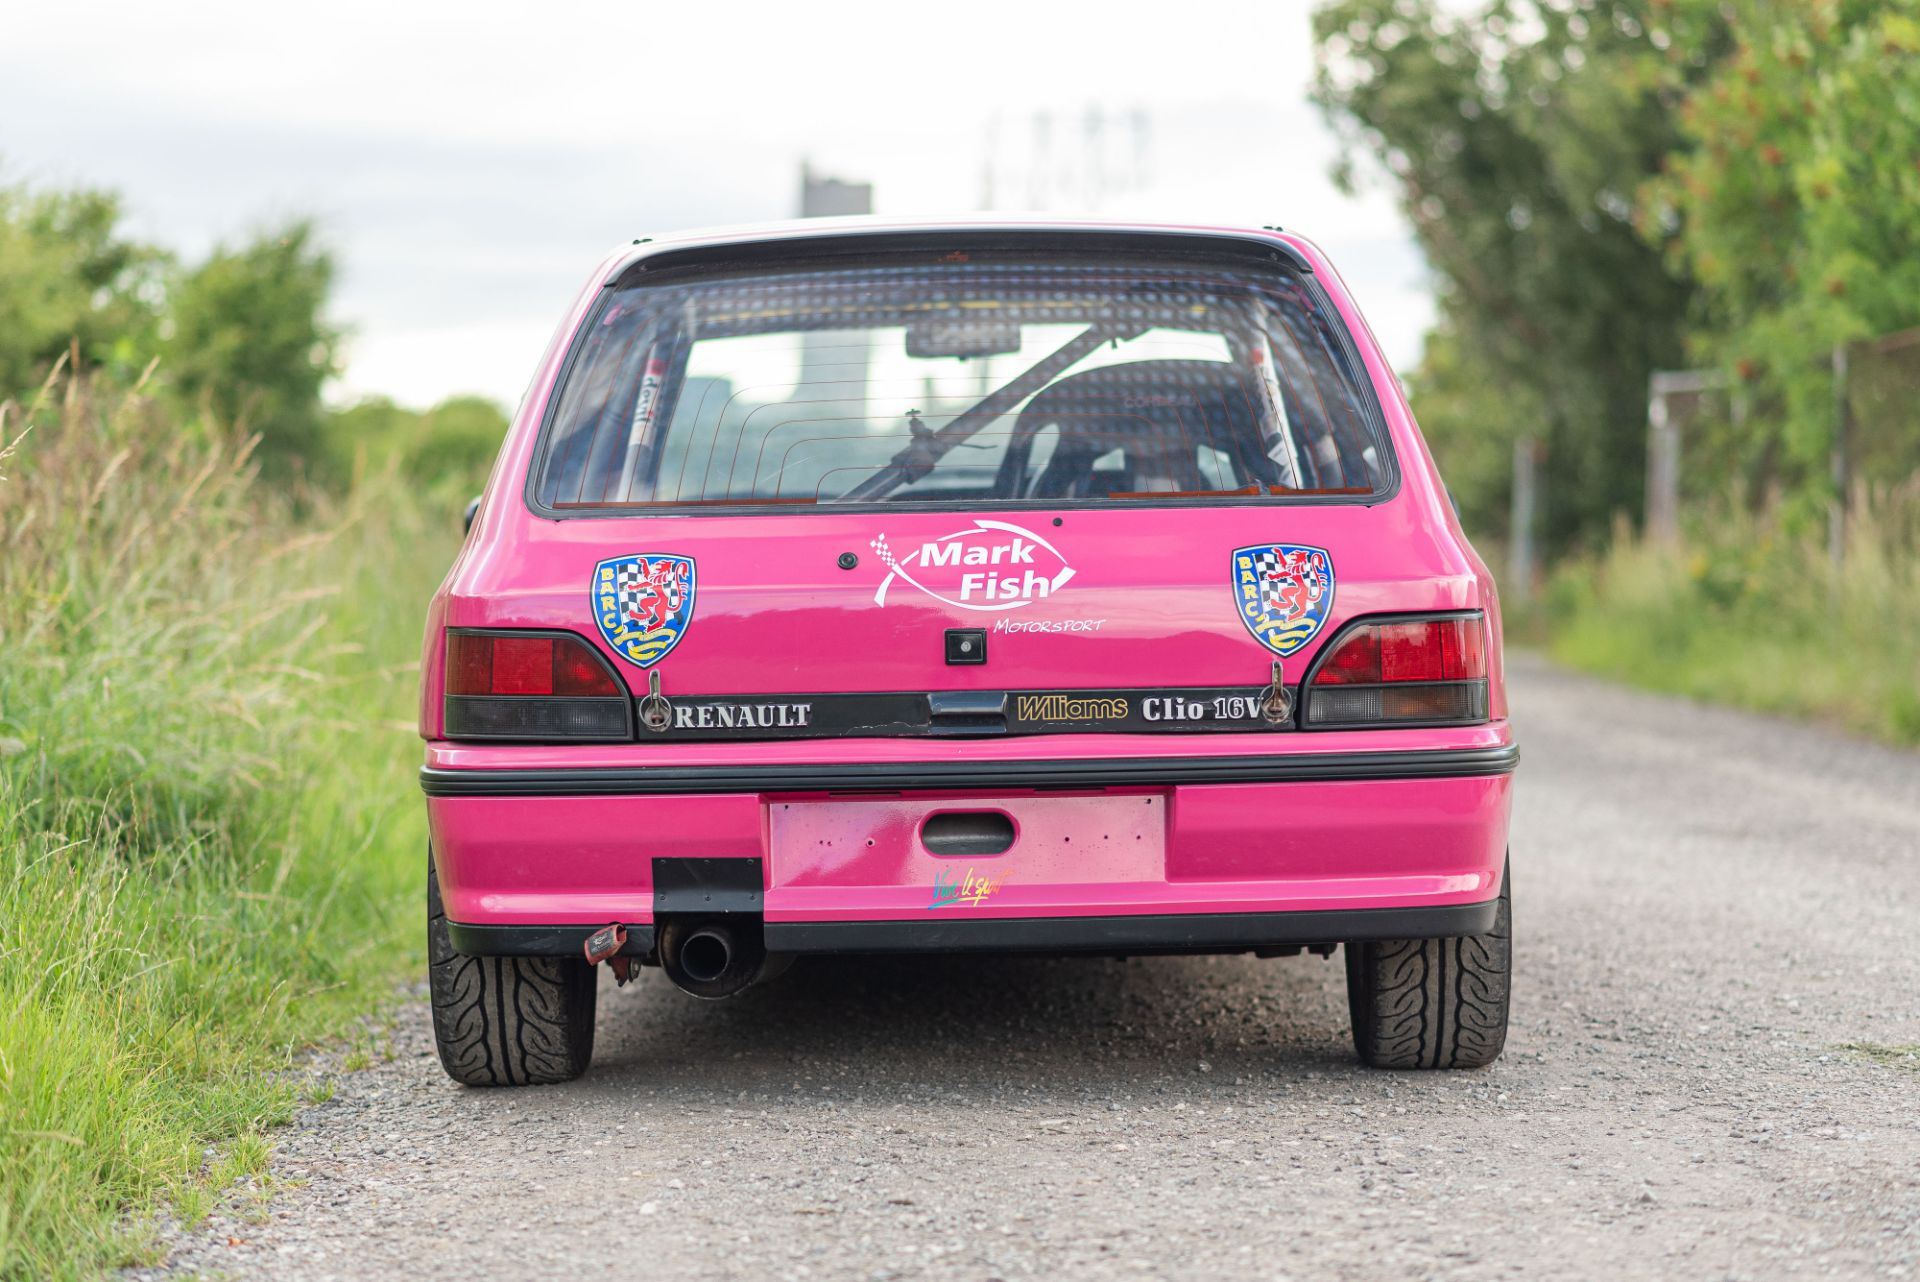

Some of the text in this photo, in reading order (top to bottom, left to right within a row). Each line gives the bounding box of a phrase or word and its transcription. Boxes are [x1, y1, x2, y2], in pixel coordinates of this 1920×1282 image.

[919, 538, 1036, 567] Mark
[600, 567, 617, 629] BARC
[960, 569, 1050, 600] Fish
[1237, 556, 1259, 617] BARC
[993, 618, 1106, 634] MOTORSPORT
[674, 703, 811, 728] RENAULT
[1017, 695, 1128, 720] Williams
[1142, 697, 1264, 721] Clio 16V
